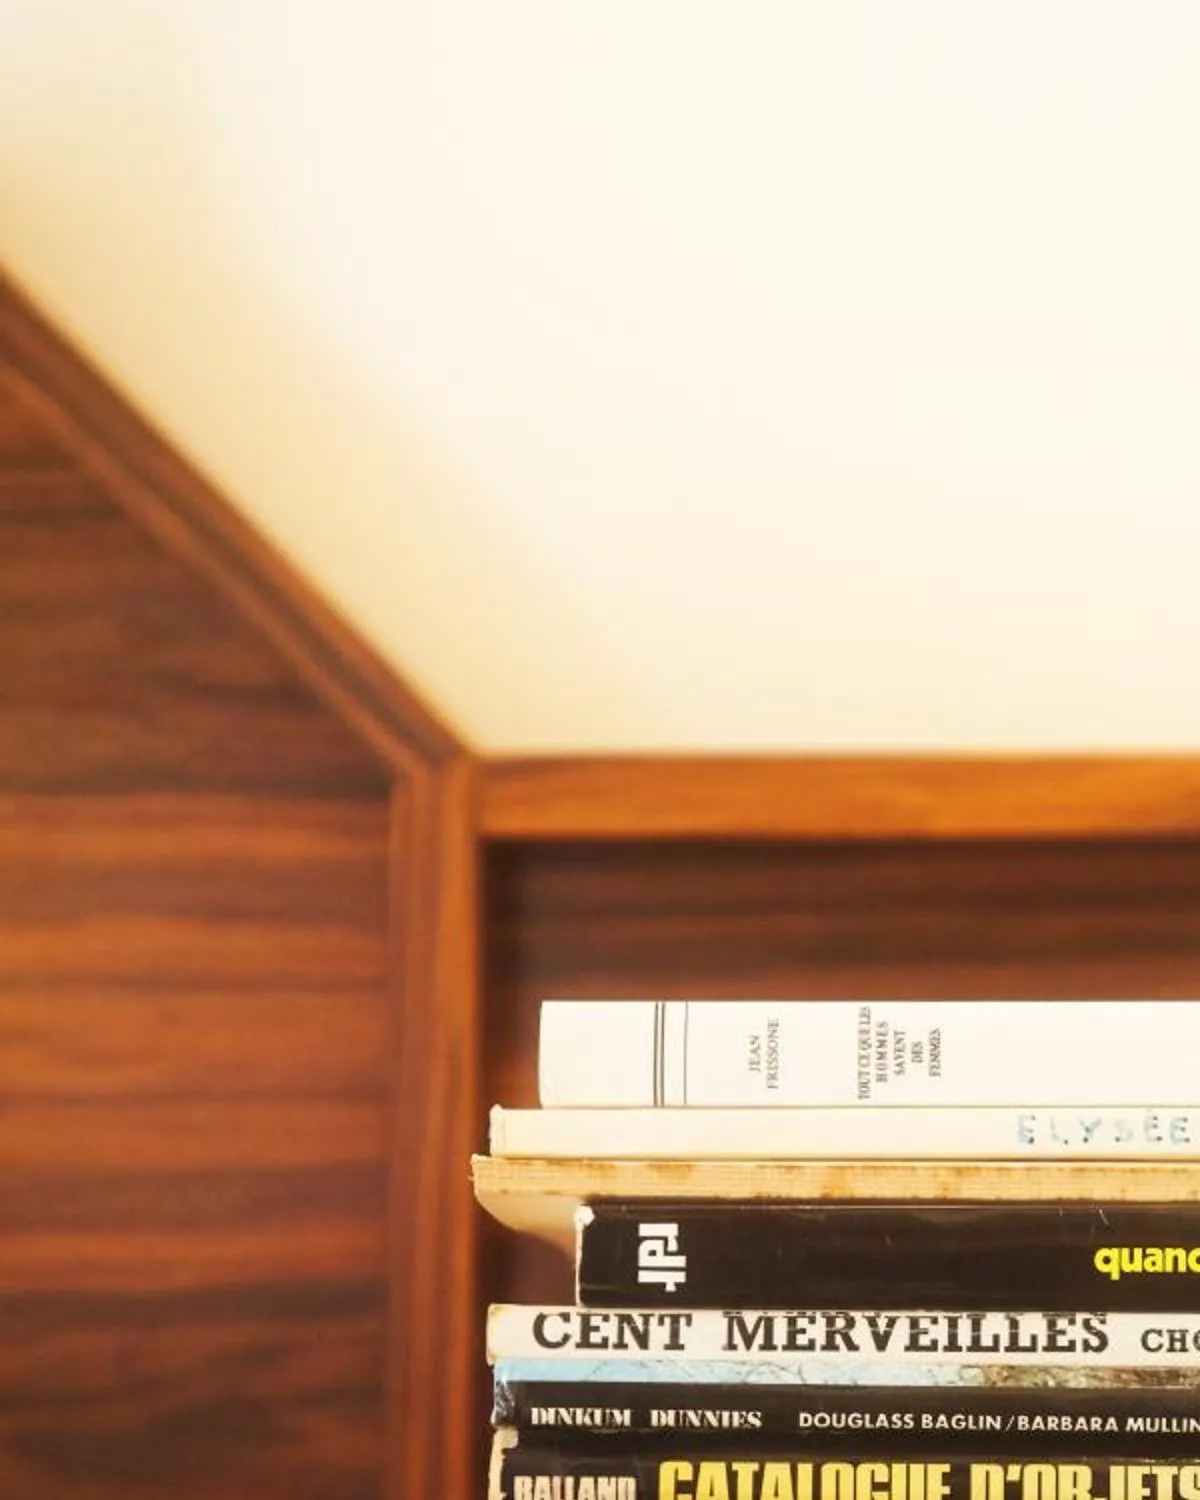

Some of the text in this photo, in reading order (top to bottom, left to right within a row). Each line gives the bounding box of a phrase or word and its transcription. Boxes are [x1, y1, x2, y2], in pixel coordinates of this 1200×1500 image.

[749, 1035, 762, 1072] JEAN
[876, 1021, 888, 1083] HOMMES
[911, 1041, 923, 1063] DES
[929, 1028, 941, 1077] FEMMES
[858, 1071, 871, 1100] TOUT
[532, 1311, 693, 1351] CENT
[721, 1310, 1108, 1353] MERVEILLES
[531, 1407, 632, 1427] DINKUM
[650, 1409, 763, 1428] DUNNIES
[800, 1411, 915, 1430] DOUGLASS
